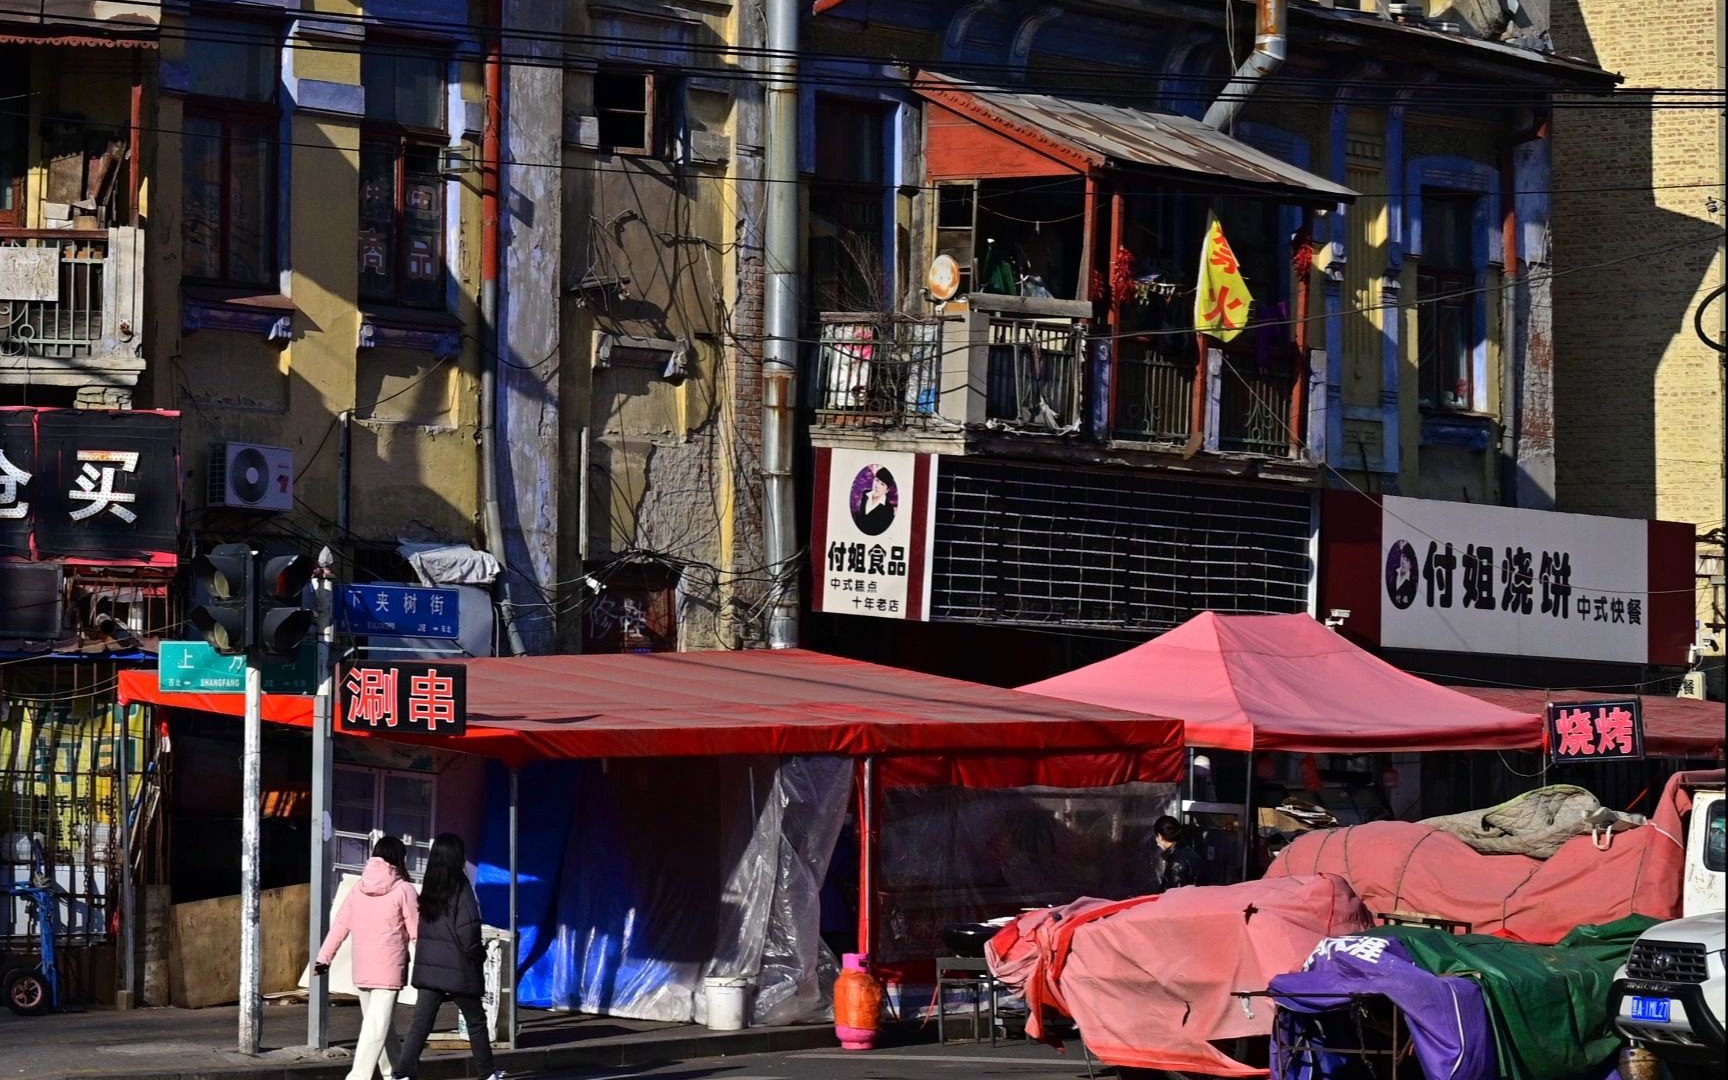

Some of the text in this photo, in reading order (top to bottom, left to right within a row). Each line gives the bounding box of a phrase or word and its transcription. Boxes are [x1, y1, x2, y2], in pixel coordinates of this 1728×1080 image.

[828, 541, 905, 576] 付姐食品
[830, 577, 877, 593] 中式糕点
[1422, 541, 1571, 619] 付姐烧饼
[348, 590, 444, 615] 下夹树街
[852, 595, 899, 612] 十年老店
[1577, 595, 1642, 625] 中式快餐
[200, 679, 239, 687] SHANGFANG
[348, 667, 455, 731] 涮串
[1556, 706, 1633, 756] 烧烤
